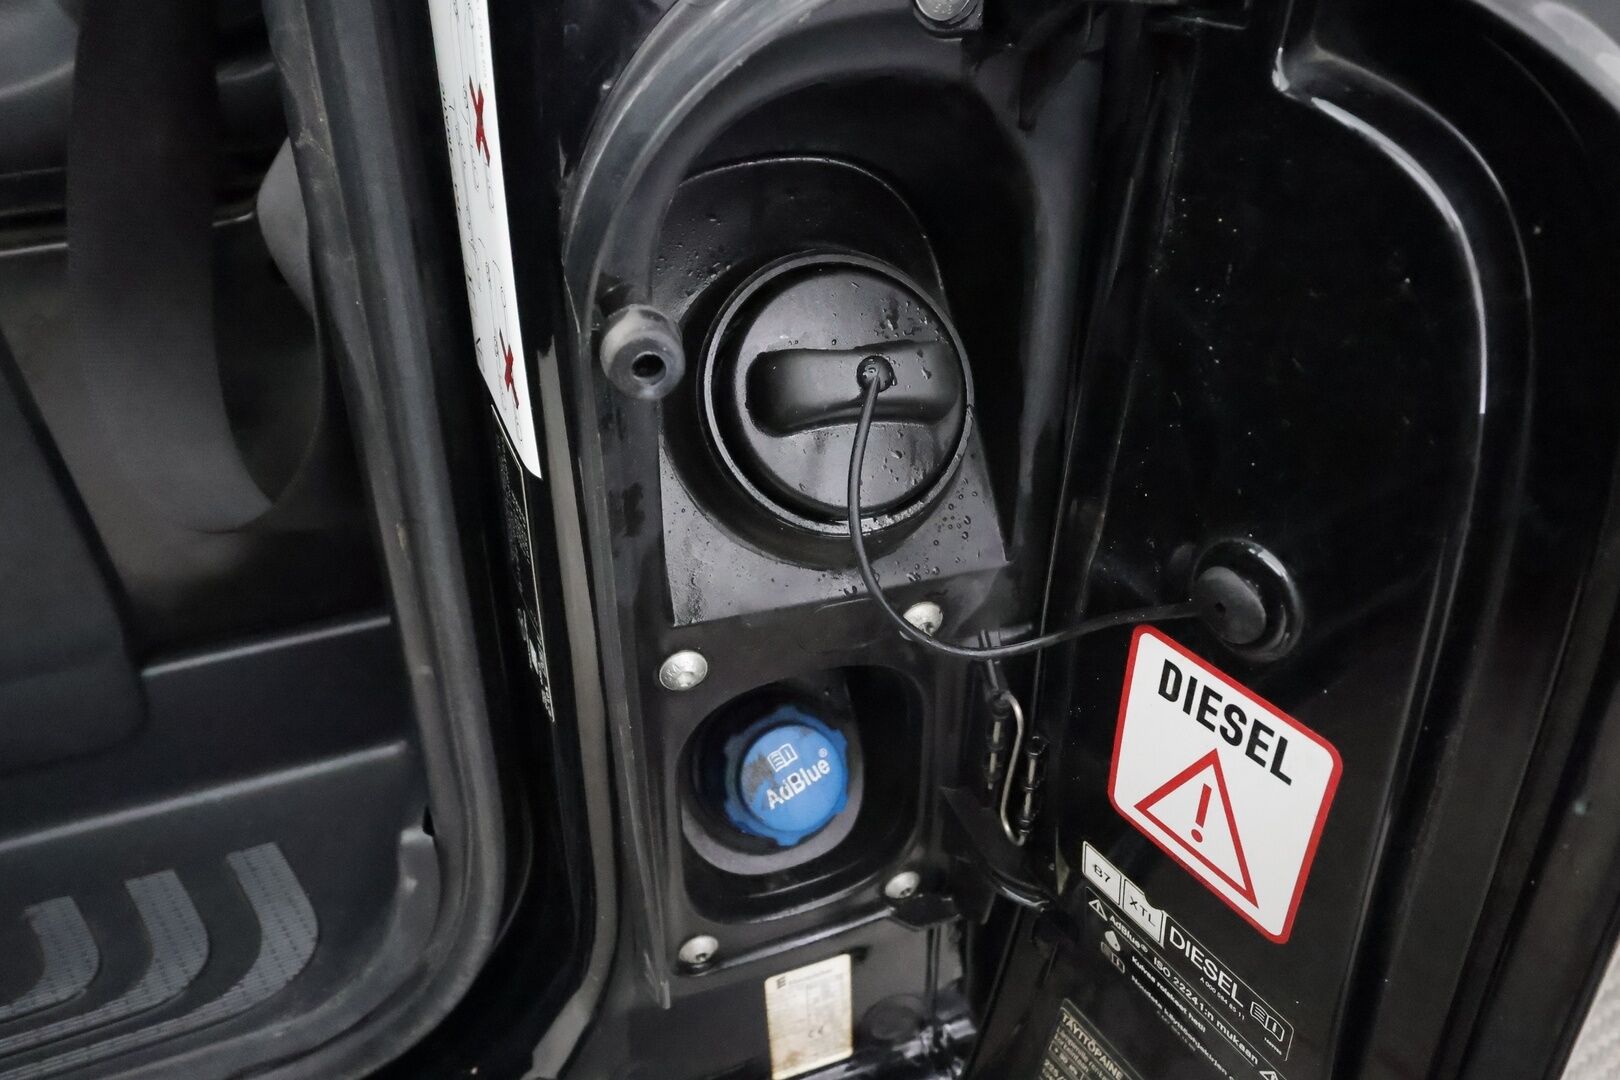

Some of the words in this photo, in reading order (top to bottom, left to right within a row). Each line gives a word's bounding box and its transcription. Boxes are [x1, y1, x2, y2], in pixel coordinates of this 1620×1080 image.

[1158, 658, 1292, 786] DIESEL
[1093, 864, 1111, 883] B7
[1129, 896, 1155, 927] XTL
[1169, 926, 1244, 1008] DIESEL
[1153, 957, 1171, 978] ISO
[1216, 1020, 1258, 1065] mukaan
